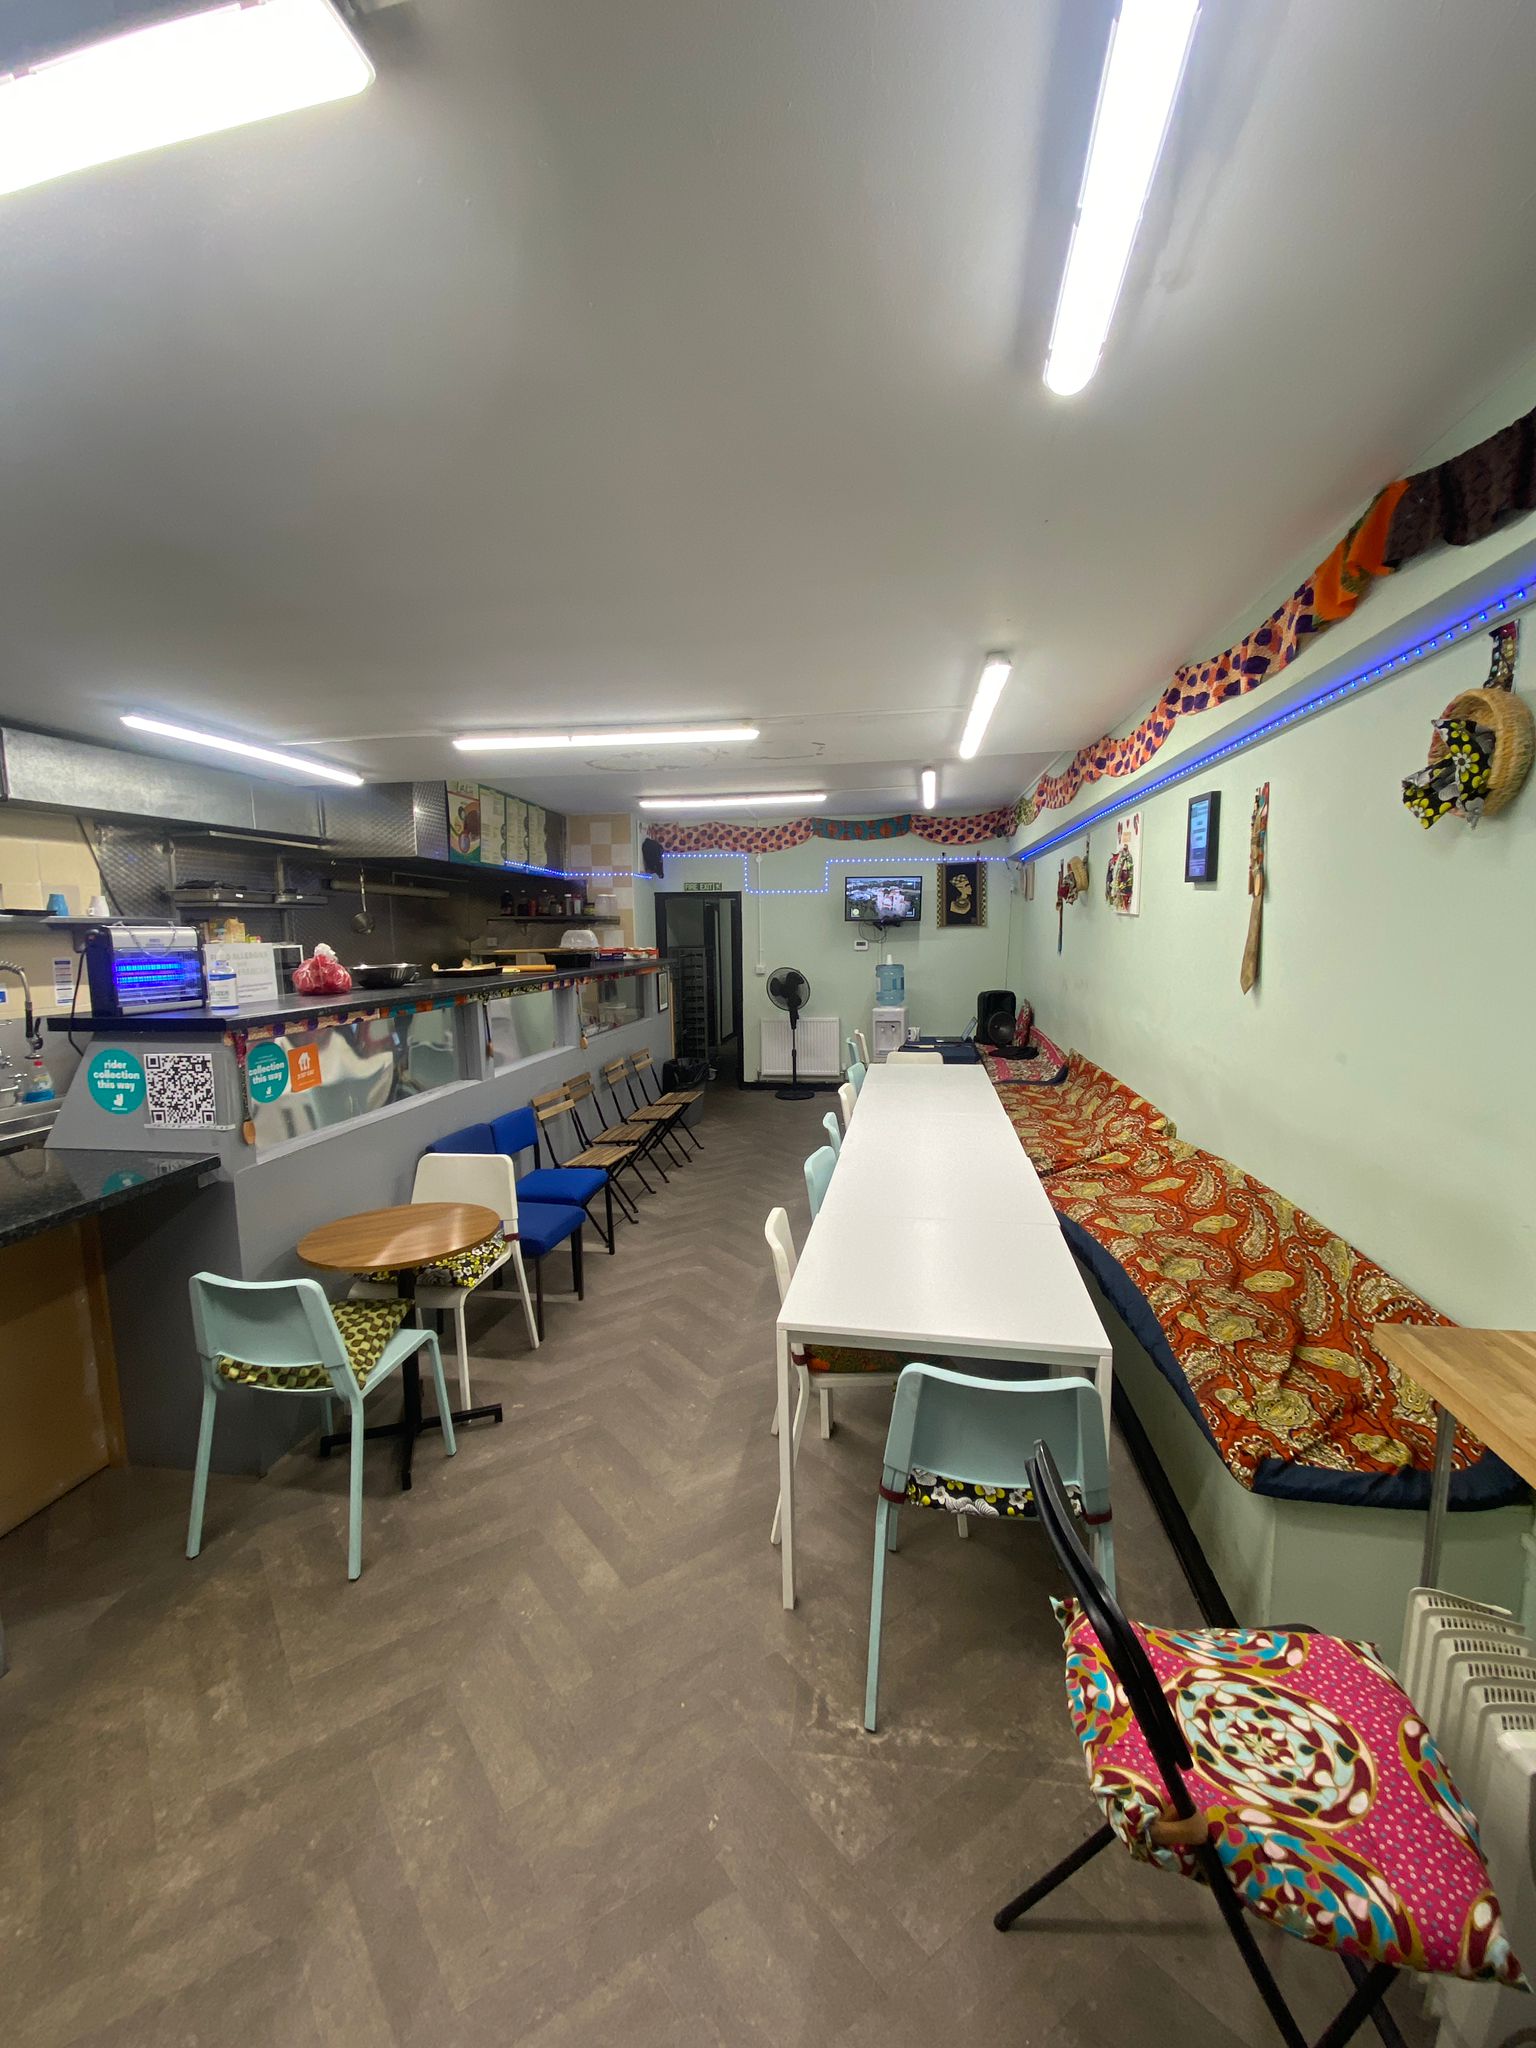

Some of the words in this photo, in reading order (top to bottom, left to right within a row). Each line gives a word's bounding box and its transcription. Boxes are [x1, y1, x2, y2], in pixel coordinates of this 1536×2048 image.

[104, 1060, 127, 1069] rider
[248, 1062, 285, 1076] collection
[93, 1070, 140, 1080] collection
[252, 1074, 267, 1085] this
[268, 1072, 282, 1081] way
[97, 1080, 115, 1089] this
[116, 1083, 135, 1093] way
